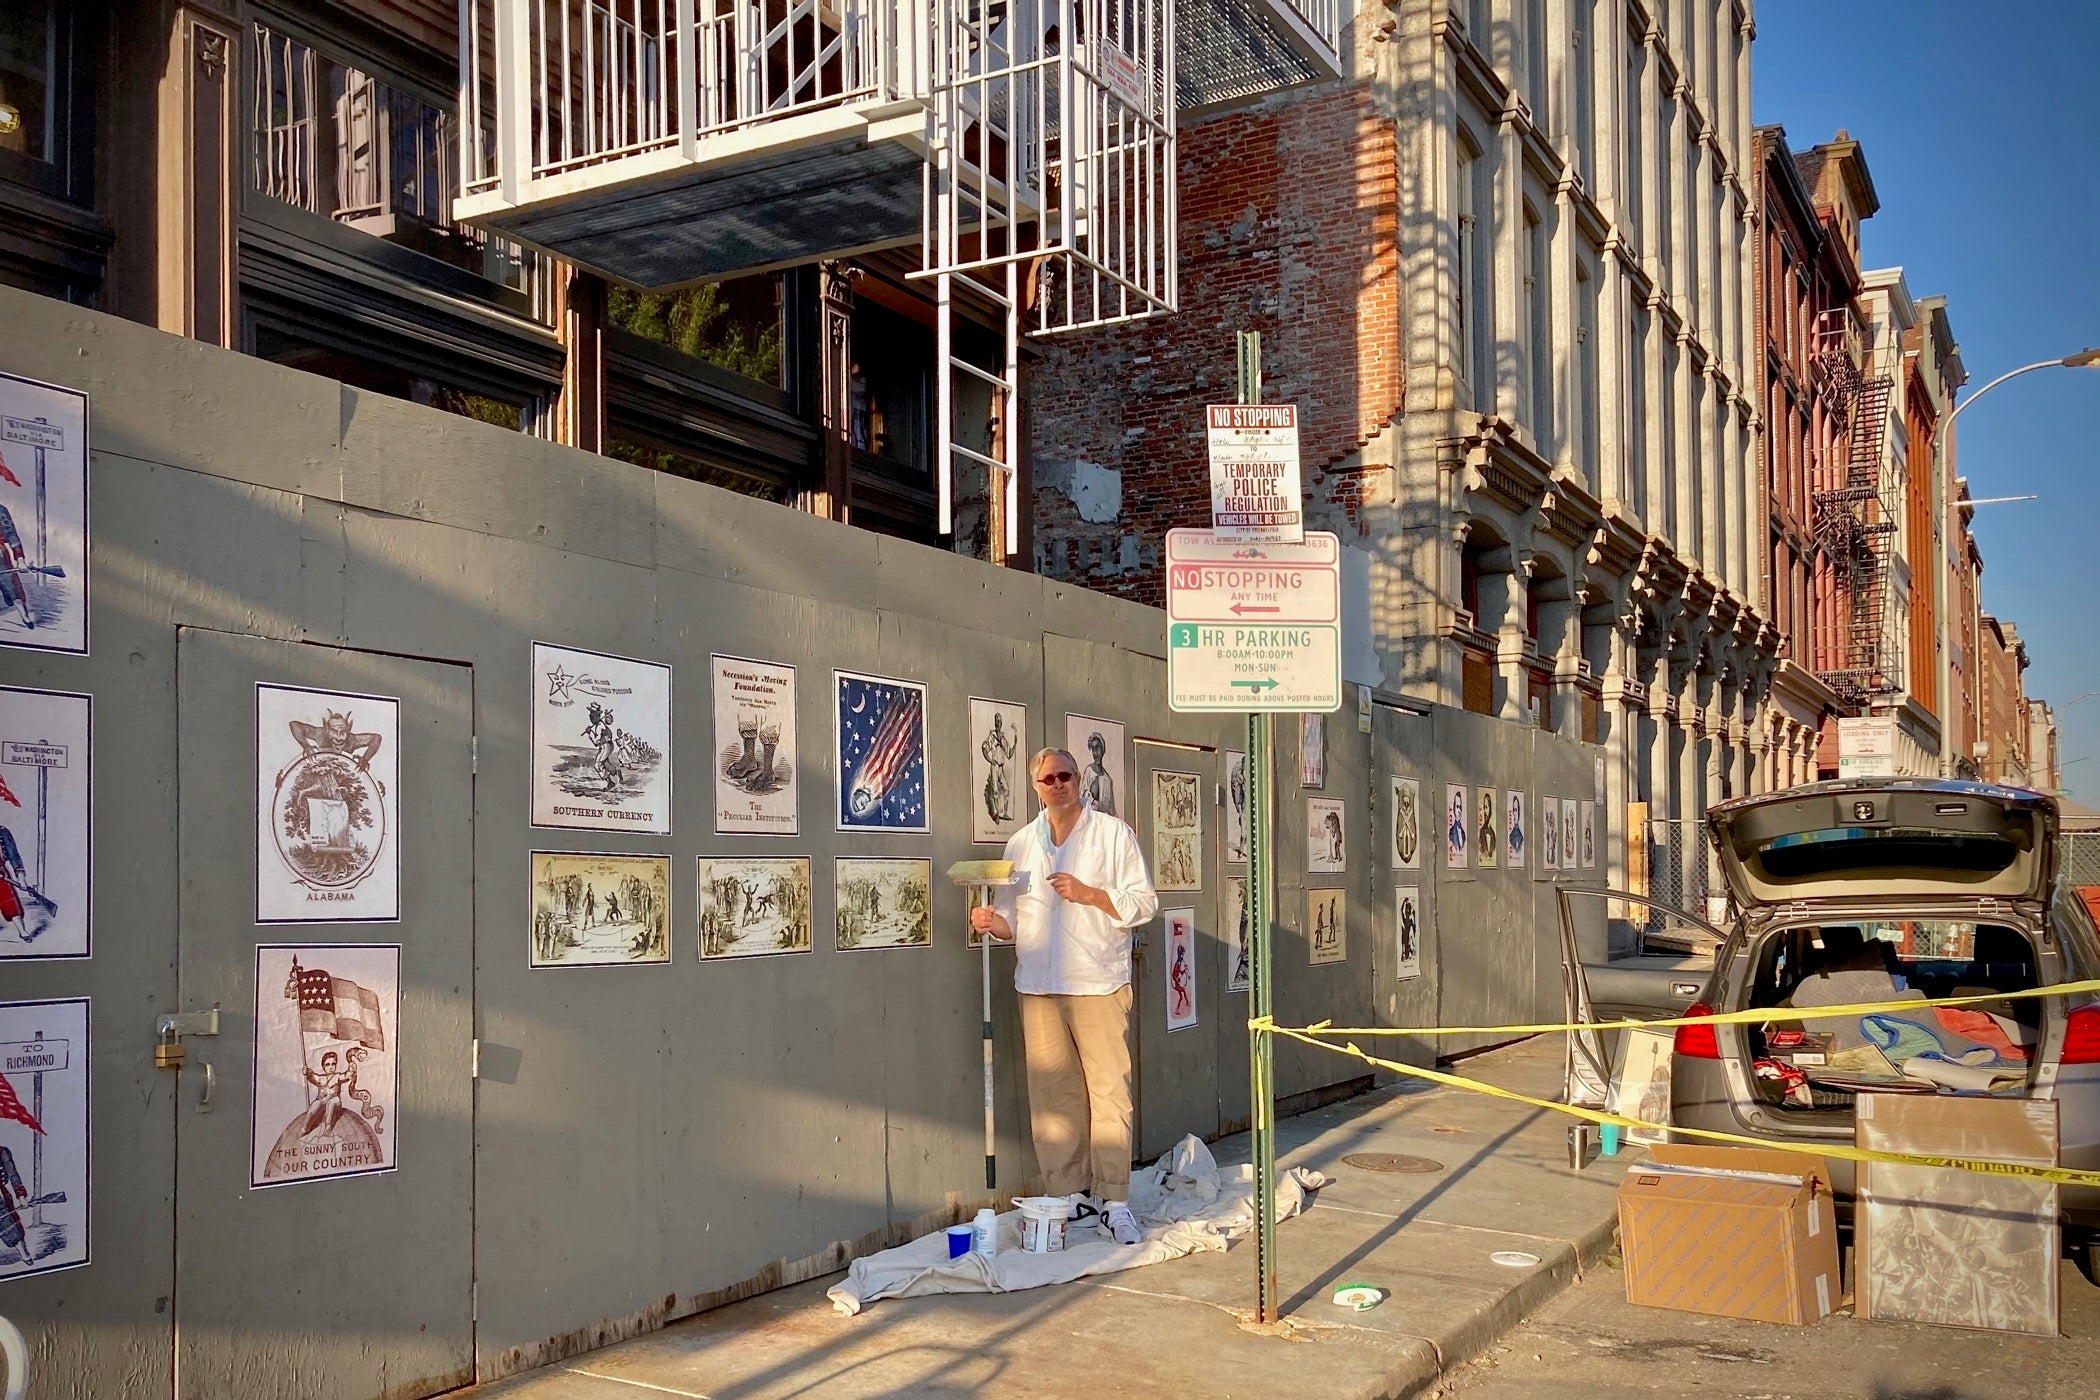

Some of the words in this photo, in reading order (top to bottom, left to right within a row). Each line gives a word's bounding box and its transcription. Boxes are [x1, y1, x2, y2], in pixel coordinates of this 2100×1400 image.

[1214, 408, 1230, 427] NO
[1234, 408, 1290, 427] STOPPING
[7, 431, 56, 447] BALTIMORE
[1223, 463, 1286, 478] TEMPORARY
[1233, 478, 1278, 496] POLICE
[1225, 496, 1288, 512] REGULATION
[1218, 514, 1247, 526] VEHICLES
[1248, 514, 1264, 525] WILL
[1265, 514, 1273, 525] BE
[1273, 513, 1297, 525] TOWED
[1178, 536, 1200, 545] TOW
[1173, 570, 1200, 588] NO
[1204, 571, 1303, 589] STOPPING
[1230, 592, 1251, 601] ANY
[1255, 592, 1278, 601] TIME
[1182, 629, 1191, 647] 3
[1203, 630, 1225, 647] HR
[1236, 630, 1312, 648] PARKING
[1217, 650, 1294, 659] 8:00AM-10:00PM
[1234, 663, 1277, 673] MON-SUN
[722, 669, 758, 682] Secession's
[761, 675, 788, 687] Moving
[733, 682, 776, 694] Foundation.
[1175, 694, 1187, 702] FEE
[1189, 694, 1206, 702] MUST
[1209, 694, 1217, 702] BE
[1219, 694, 1234, 702] PAID
[1237, 694, 1261, 702] DURING
[1264, 694, 1284, 702] ABOVE
[1287, 694, 1311, 702] POSTED
[1313, 694, 1335, 702] HOURS
[11, 755, 58, 766] BALTIMORE
[553, 806, 604, 818] SOUTHERN
[607, 810, 653, 821] CURRENCY
[306, 892, 355, 901] ALABAMA
[22, 1044, 44, 1053] TO
[6, 1054, 54, 1069] RICHMOND
[276, 1148, 298, 1158] THE
[304, 1143, 336, 1156] SUNNY
[341, 1142, 374, 1152] SOUTH
[283, 1161, 308, 1174] OUR
[313, 1155, 371, 1171] COUNTRY
